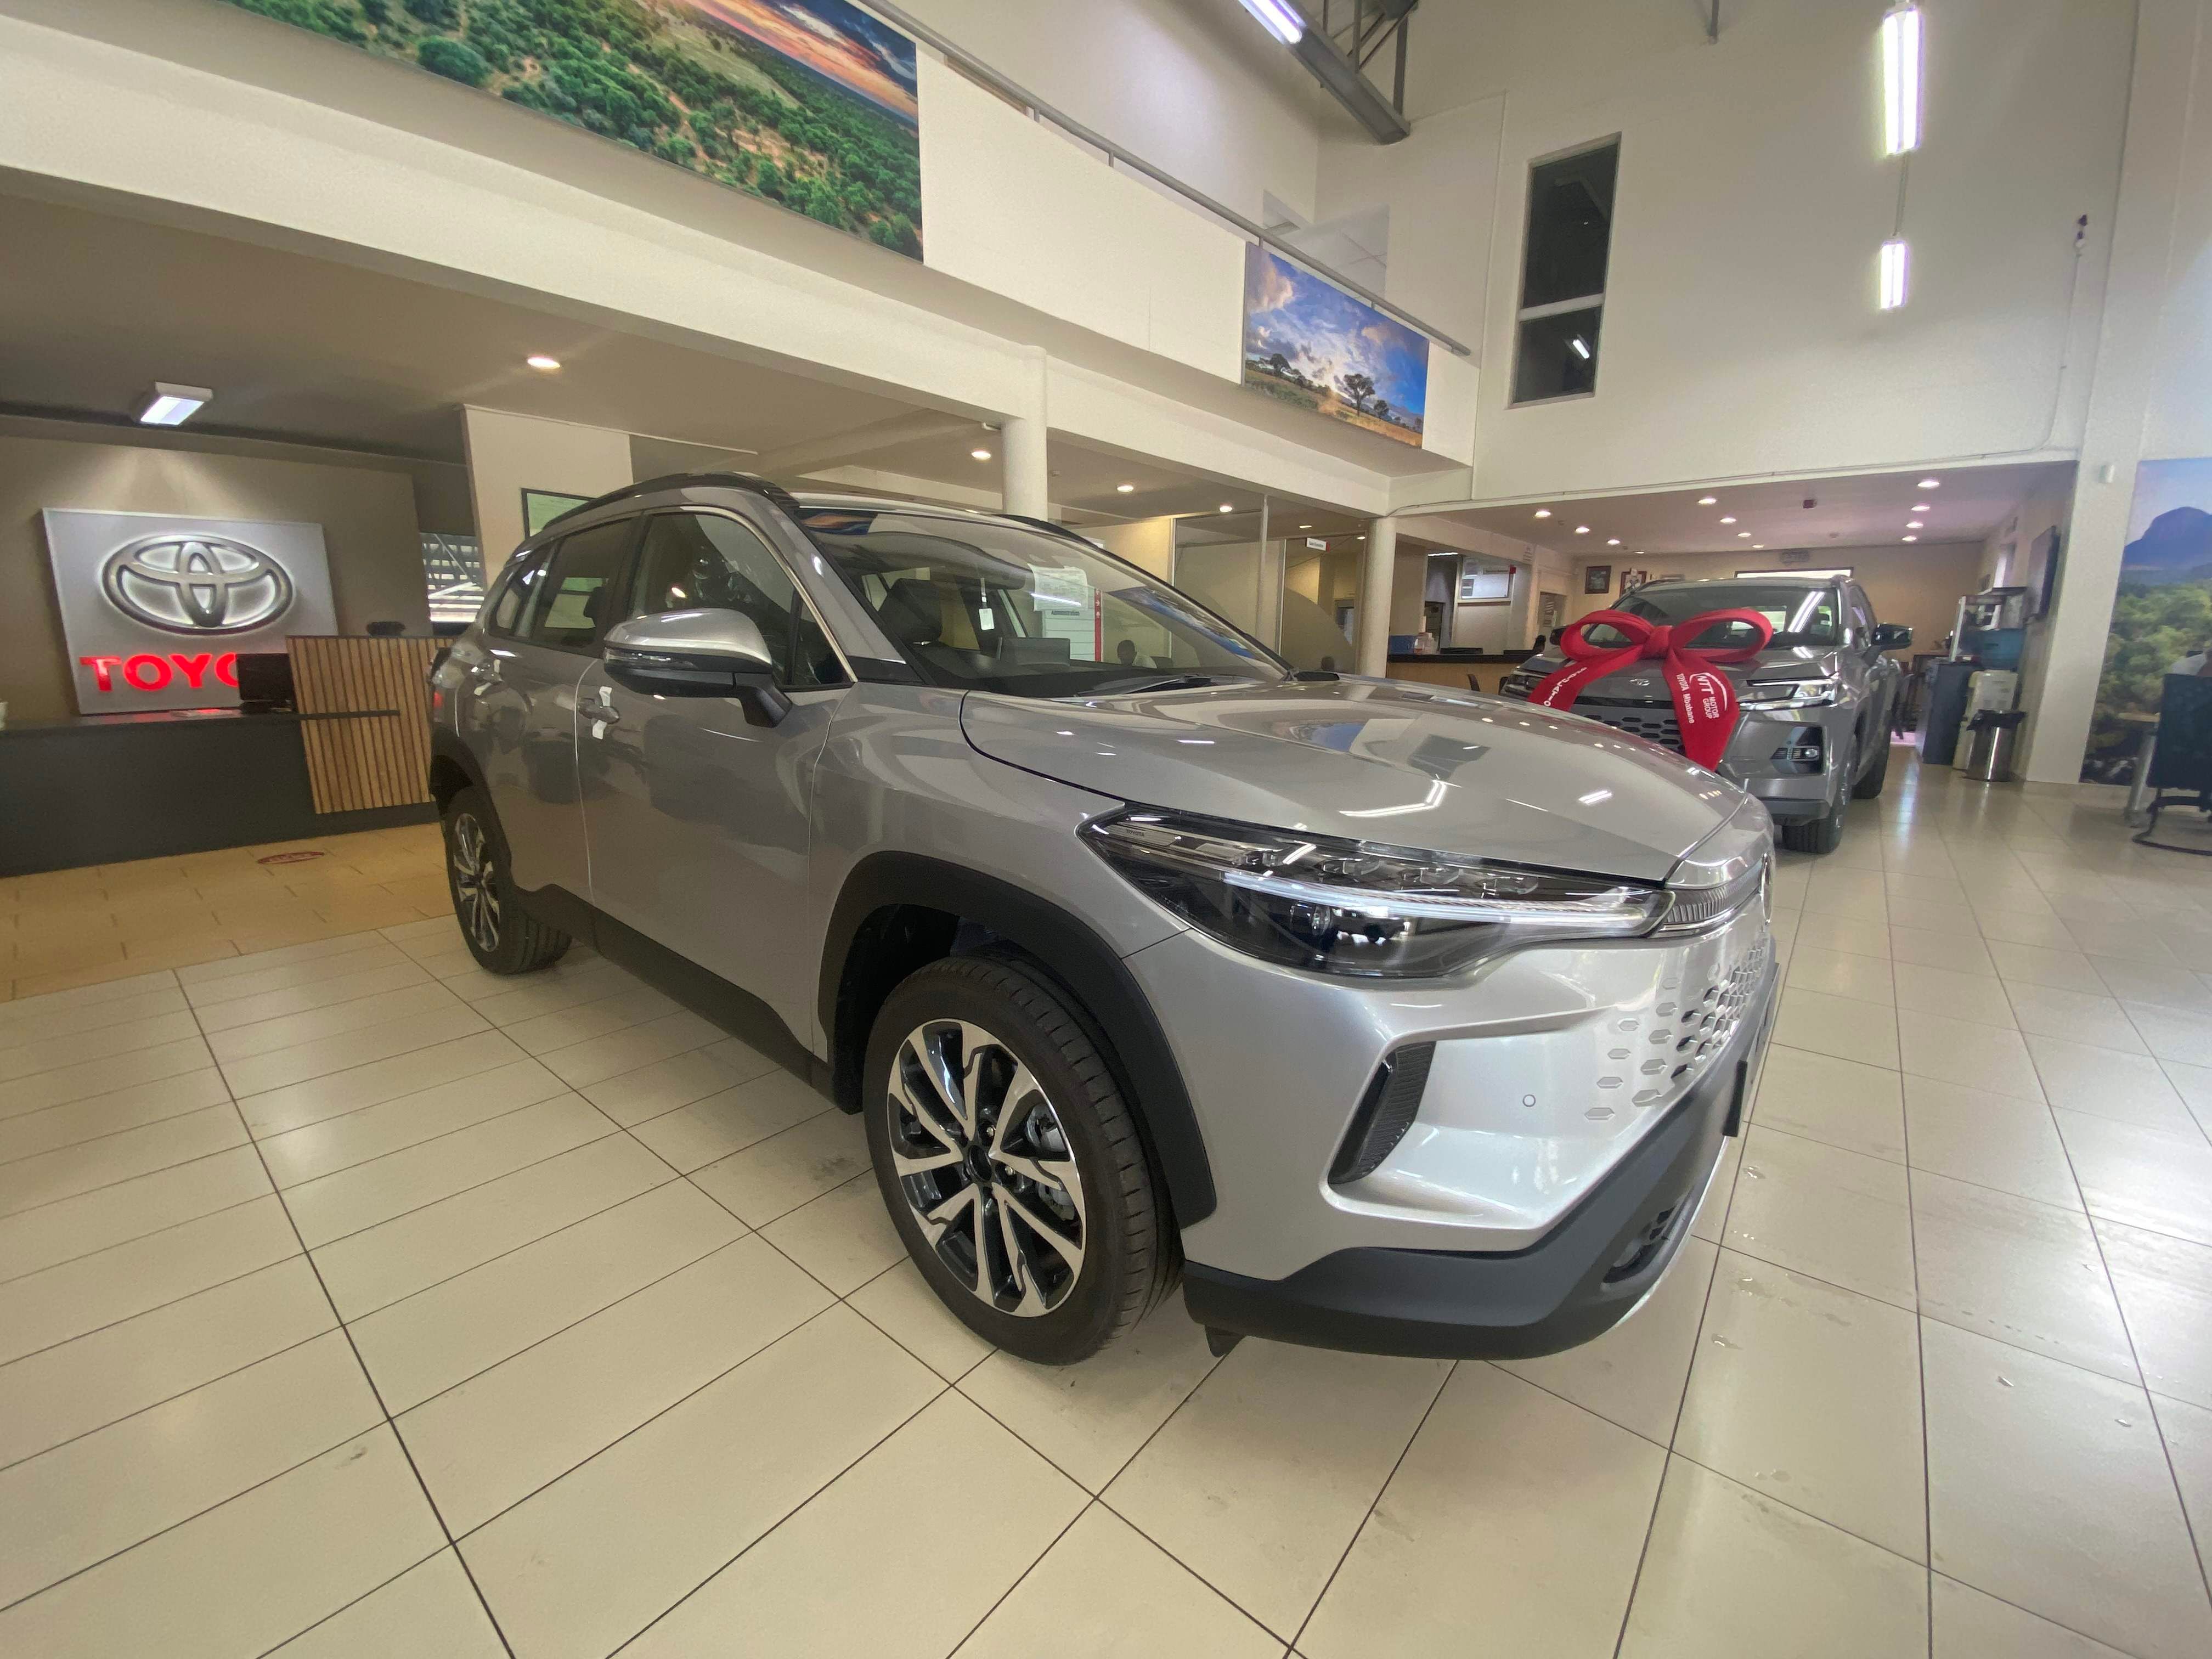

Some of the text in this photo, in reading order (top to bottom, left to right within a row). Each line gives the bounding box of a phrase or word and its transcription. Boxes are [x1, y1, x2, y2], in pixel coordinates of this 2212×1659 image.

[80, 652, 240, 691] TOYO
[1696, 675, 1714, 695] NTT
[1677, 673, 1695, 724] TOYOTA Mbabane
[1702, 698, 1713, 719] GROUP
[1709, 696, 1720, 718] MOTOR
